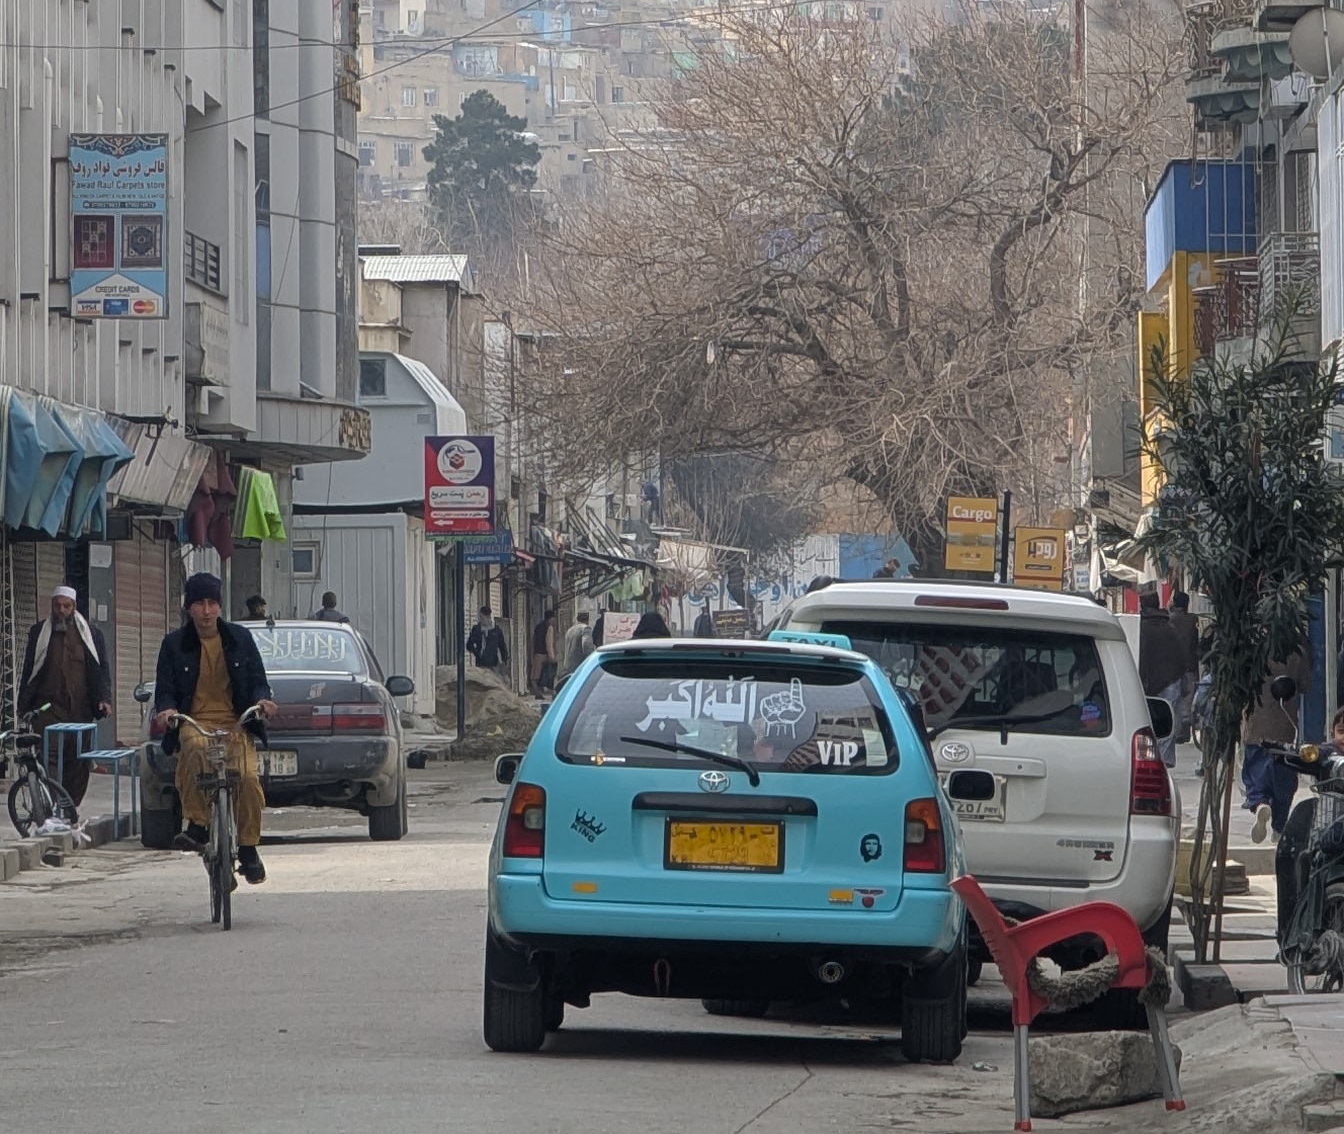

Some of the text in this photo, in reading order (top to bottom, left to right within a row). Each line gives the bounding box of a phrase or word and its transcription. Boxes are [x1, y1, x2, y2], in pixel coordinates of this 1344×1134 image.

[113, 158, 141, 178] فروشی
[952, 506, 992, 522] Cargo
[570, 823, 597, 843] KING
